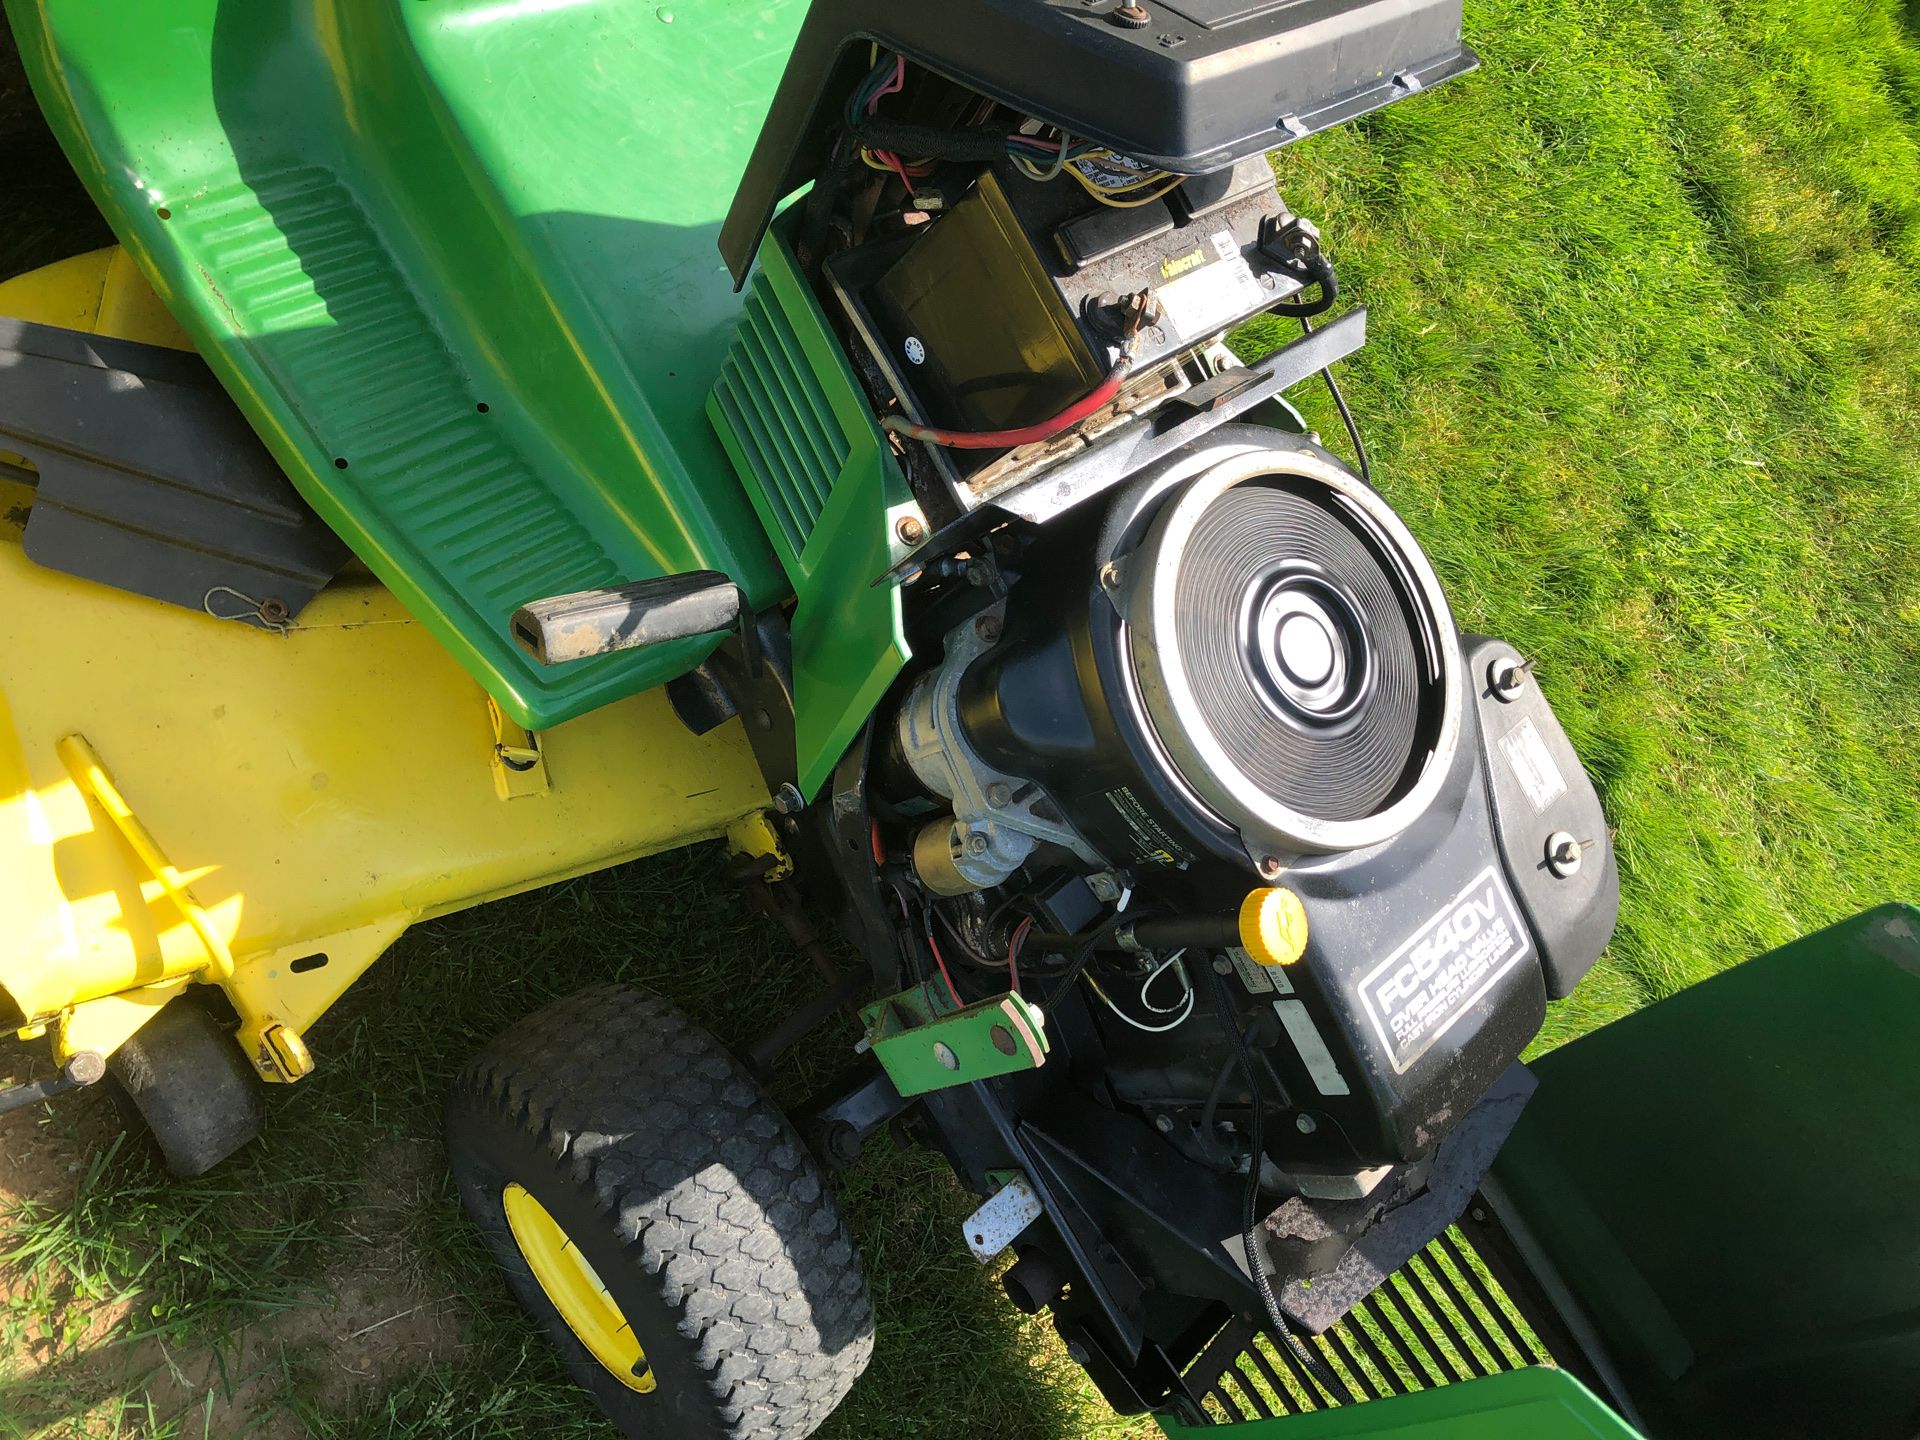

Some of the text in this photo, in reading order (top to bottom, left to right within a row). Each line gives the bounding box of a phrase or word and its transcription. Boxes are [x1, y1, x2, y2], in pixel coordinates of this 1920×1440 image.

[1121, 786, 1149, 818] BEFORE
[1376, 886, 1496, 1015] FC540V
[1390, 916, 1506, 1033] OVER HEAD VALVE
[1400, 936, 1514, 1050] CAST IRON CYLINDER LINER
[1396, 1018, 1419, 1041] FULL
